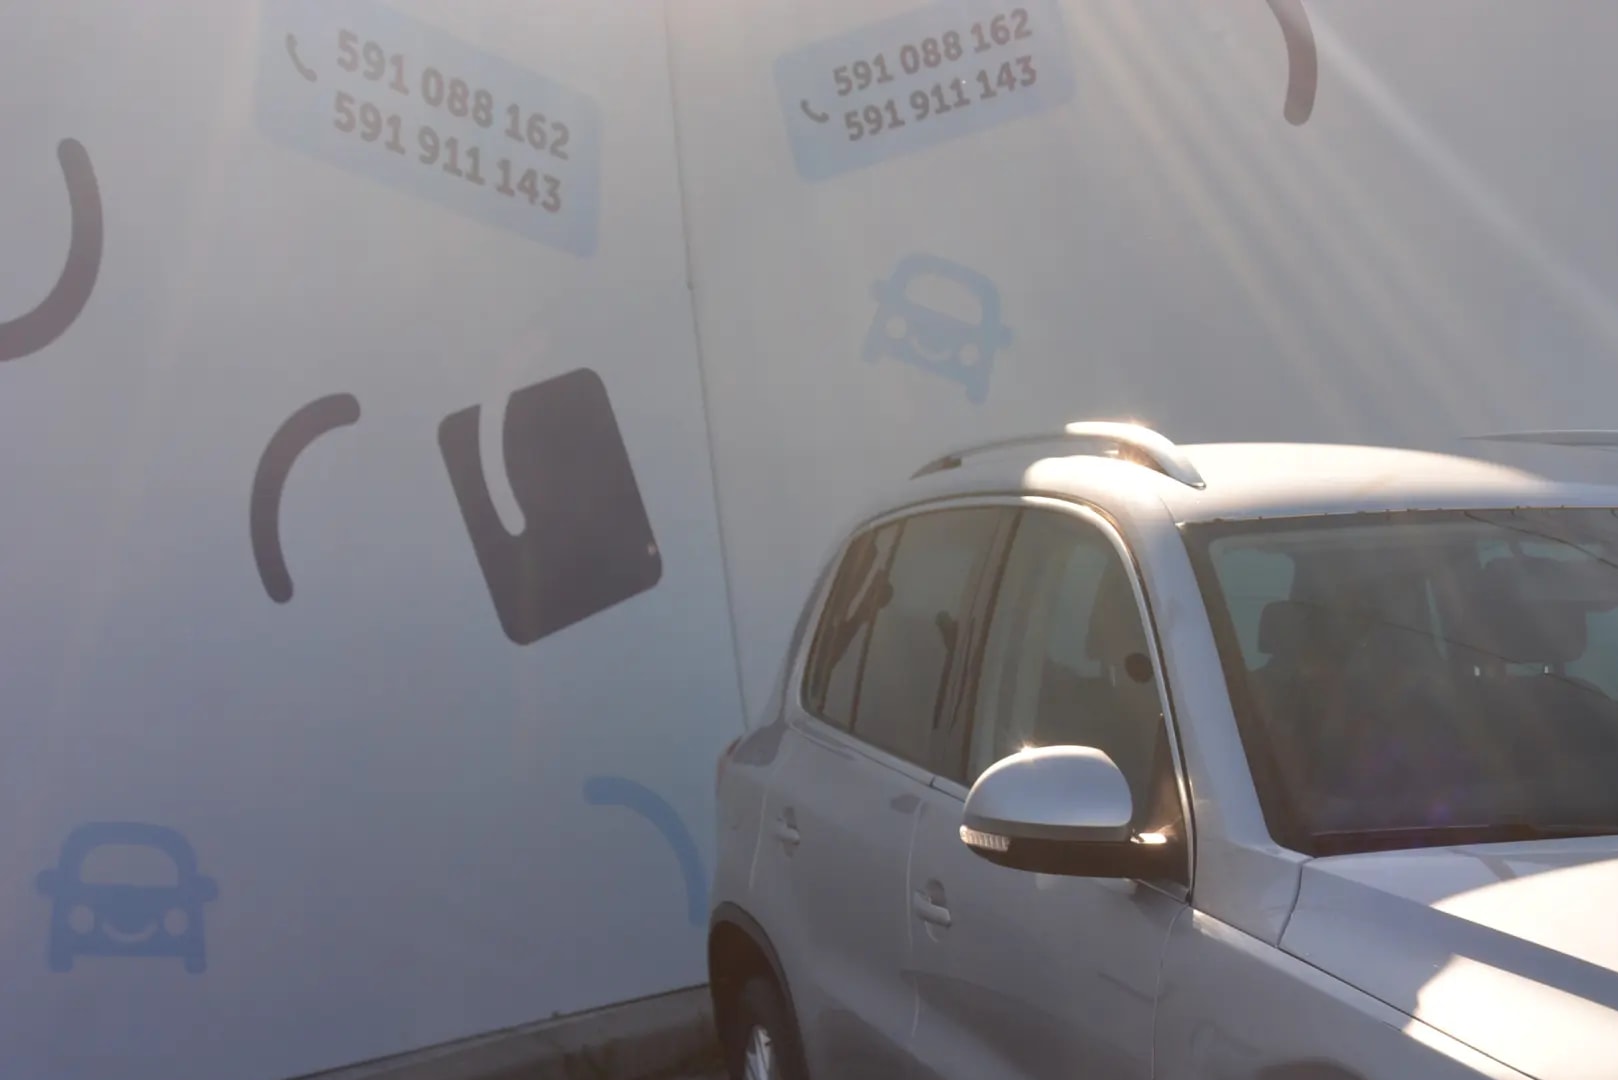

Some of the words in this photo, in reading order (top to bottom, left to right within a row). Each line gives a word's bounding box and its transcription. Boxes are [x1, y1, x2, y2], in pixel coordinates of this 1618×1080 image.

[337, 29, 410, 96] 591
[421, 67, 494, 129] 088
[504, 104, 570, 161] 162
[833, 53, 894, 96] 591
[900, 31, 963, 75] 088
[970, 8, 1033, 53] 162
[844, 99, 905, 141] 591
[909, 77, 971, 121] 911
[976, 55, 1037, 100] 143
[333, 91, 405, 156] 591
[418, 126, 485, 186] 911
[496, 159, 562, 214] 143
